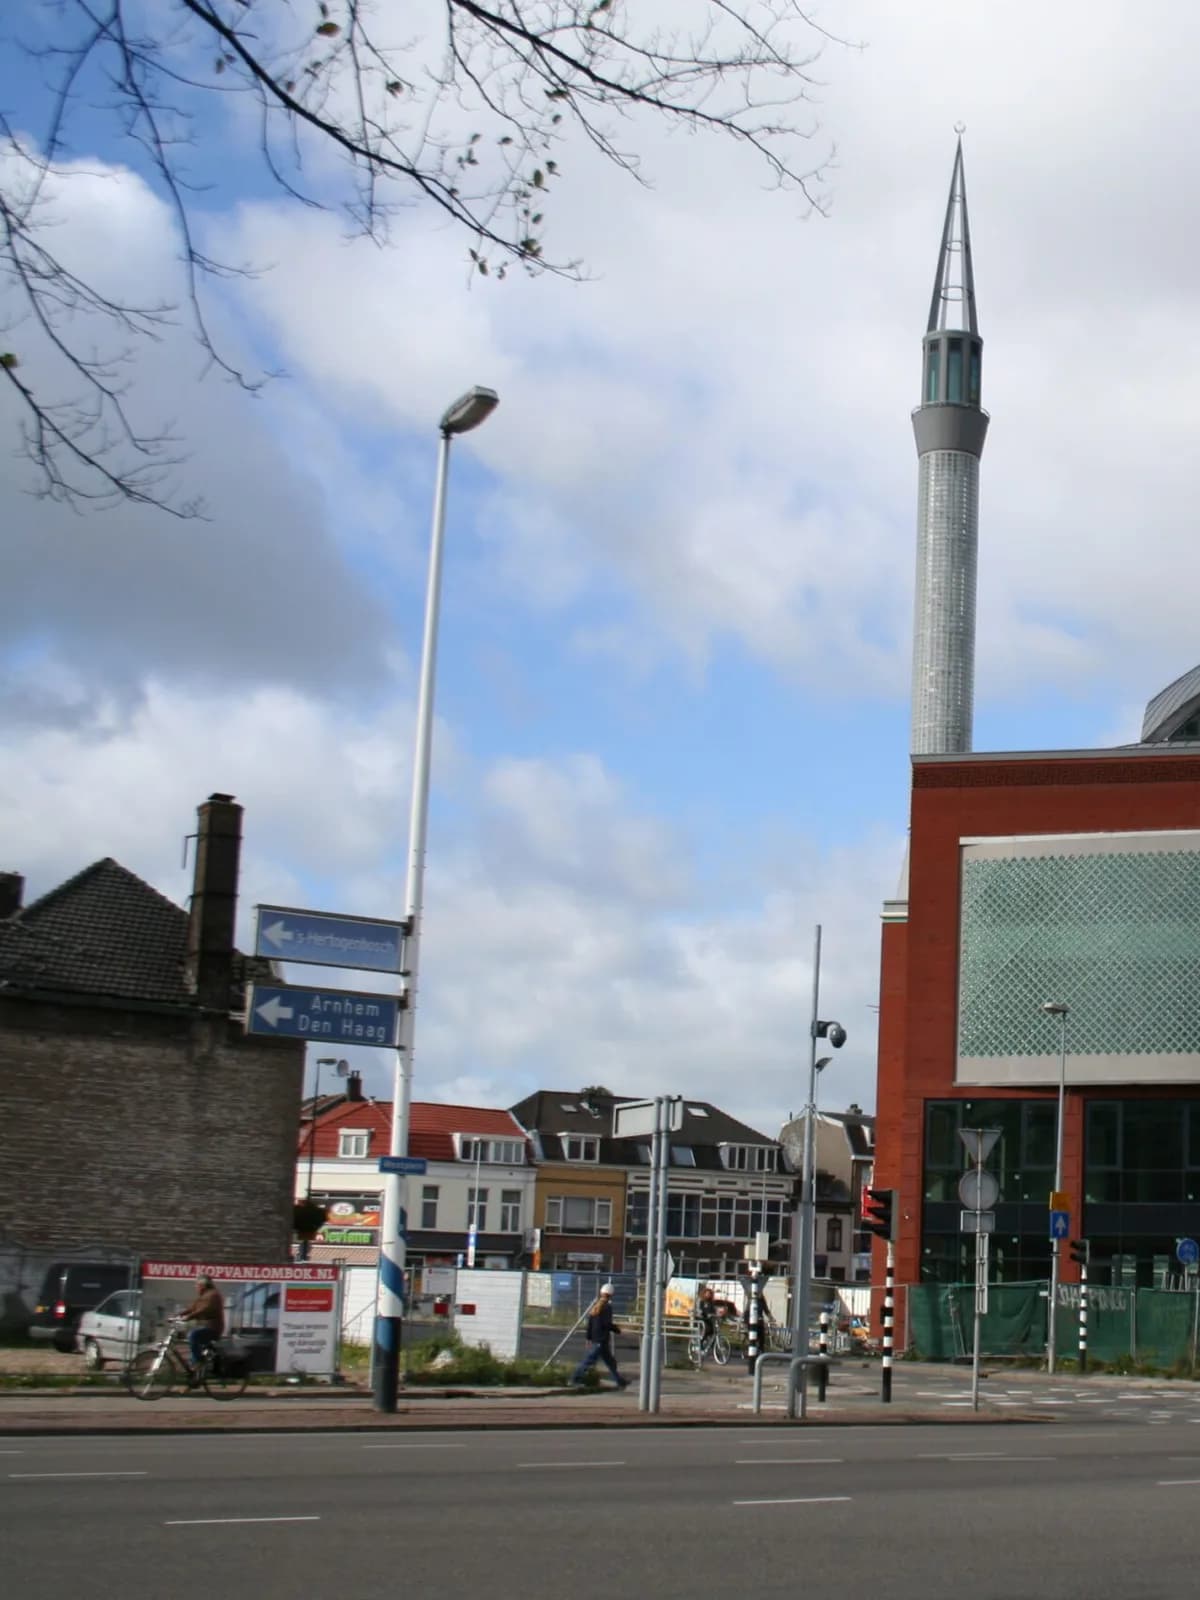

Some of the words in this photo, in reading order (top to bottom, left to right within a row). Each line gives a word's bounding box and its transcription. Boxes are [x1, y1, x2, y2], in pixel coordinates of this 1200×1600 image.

[310, 995, 380, 1017] Arnhem
[298, 1015, 331, 1033] Den
[341, 1018, 386, 1042] Haag
[147, 1263, 335, 1280] WWW.KOPVANLOMBOK.NL
